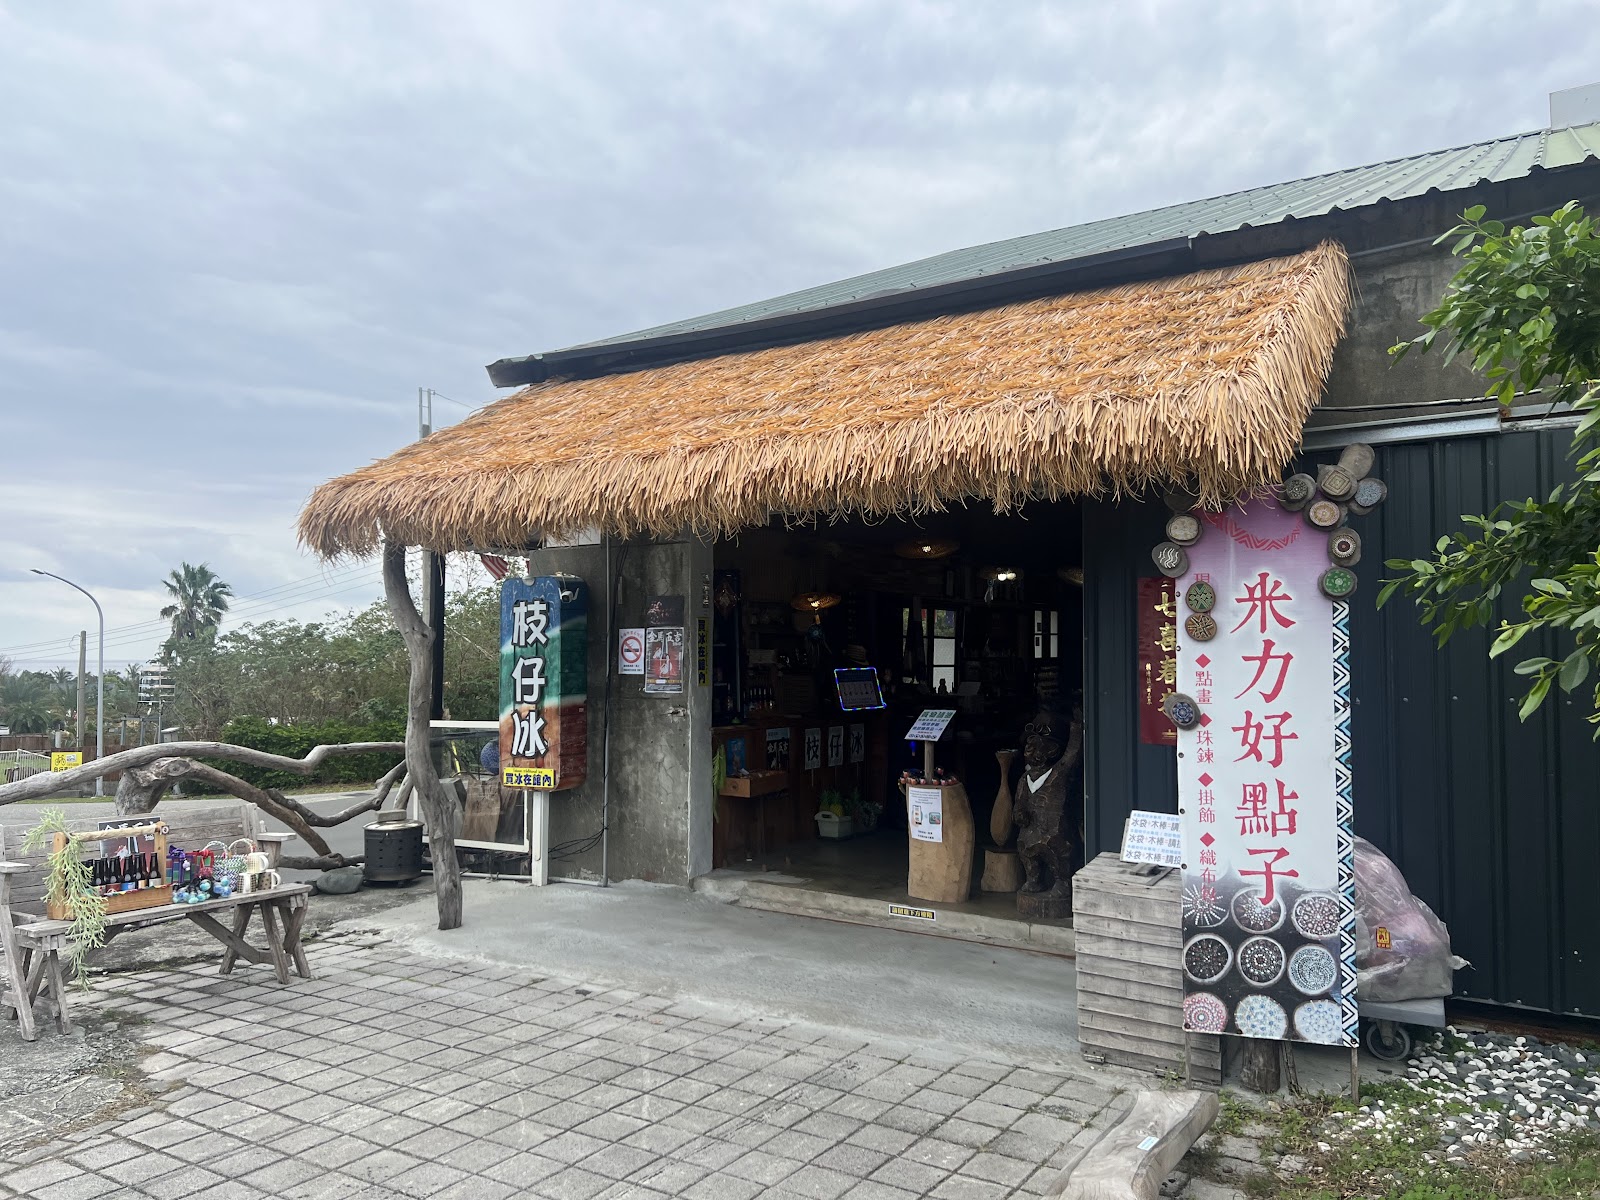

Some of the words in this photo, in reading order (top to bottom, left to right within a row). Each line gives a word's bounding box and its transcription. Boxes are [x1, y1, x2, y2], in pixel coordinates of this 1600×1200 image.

[512, 600, 548, 757] 枝仔冰
[1195, 670, 1212, 705] 點畫
[1196, 730, 1214, 764] 珠鍊
[1230, 572, 1299, 906] 米力好點子
[505, 772, 553, 786] 買冰在館內
[1198, 789, 1215, 823] 掛飾
